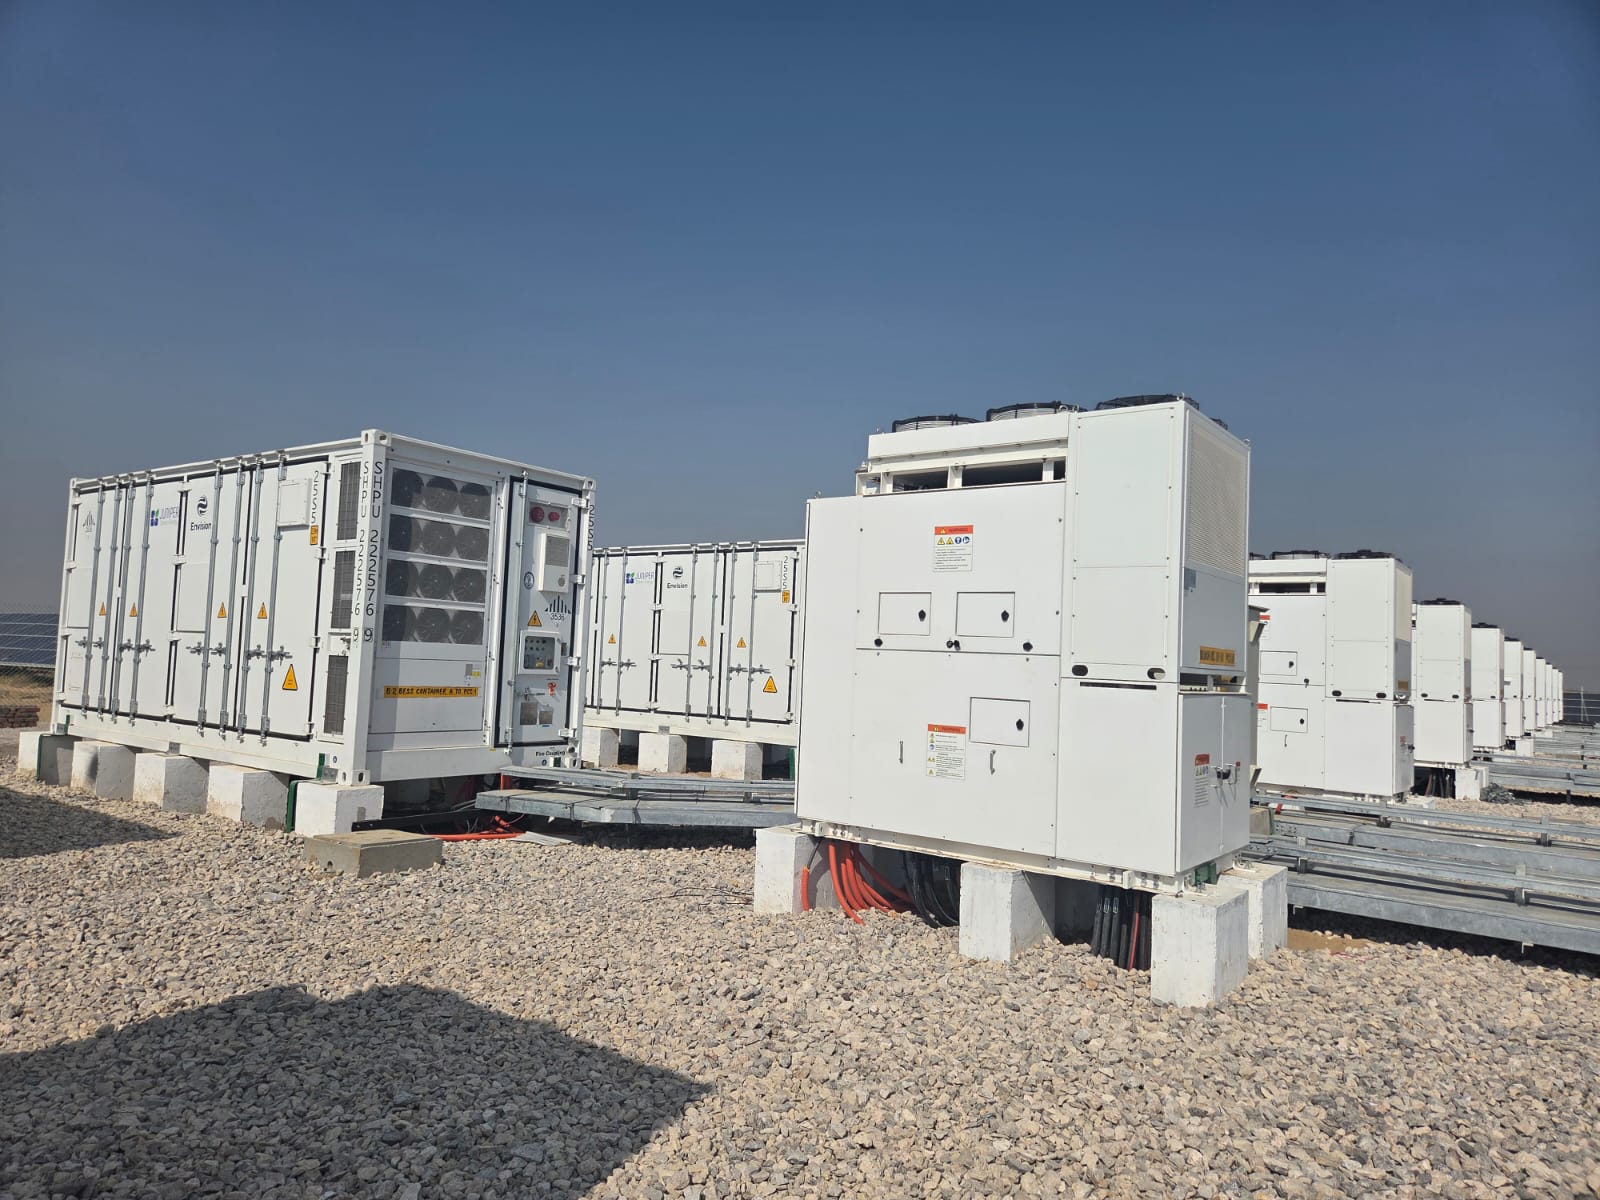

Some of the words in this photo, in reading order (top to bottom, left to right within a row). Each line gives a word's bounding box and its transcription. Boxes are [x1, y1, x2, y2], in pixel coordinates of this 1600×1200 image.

[361, 461, 369, 518] SHPU
[372, 461, 383, 518] SHPU
[190, 522, 212, 531] Envision
[355, 529, 365, 616] 222576
[366, 529, 379, 616] 222576
[363, 628, 373, 642] 9
